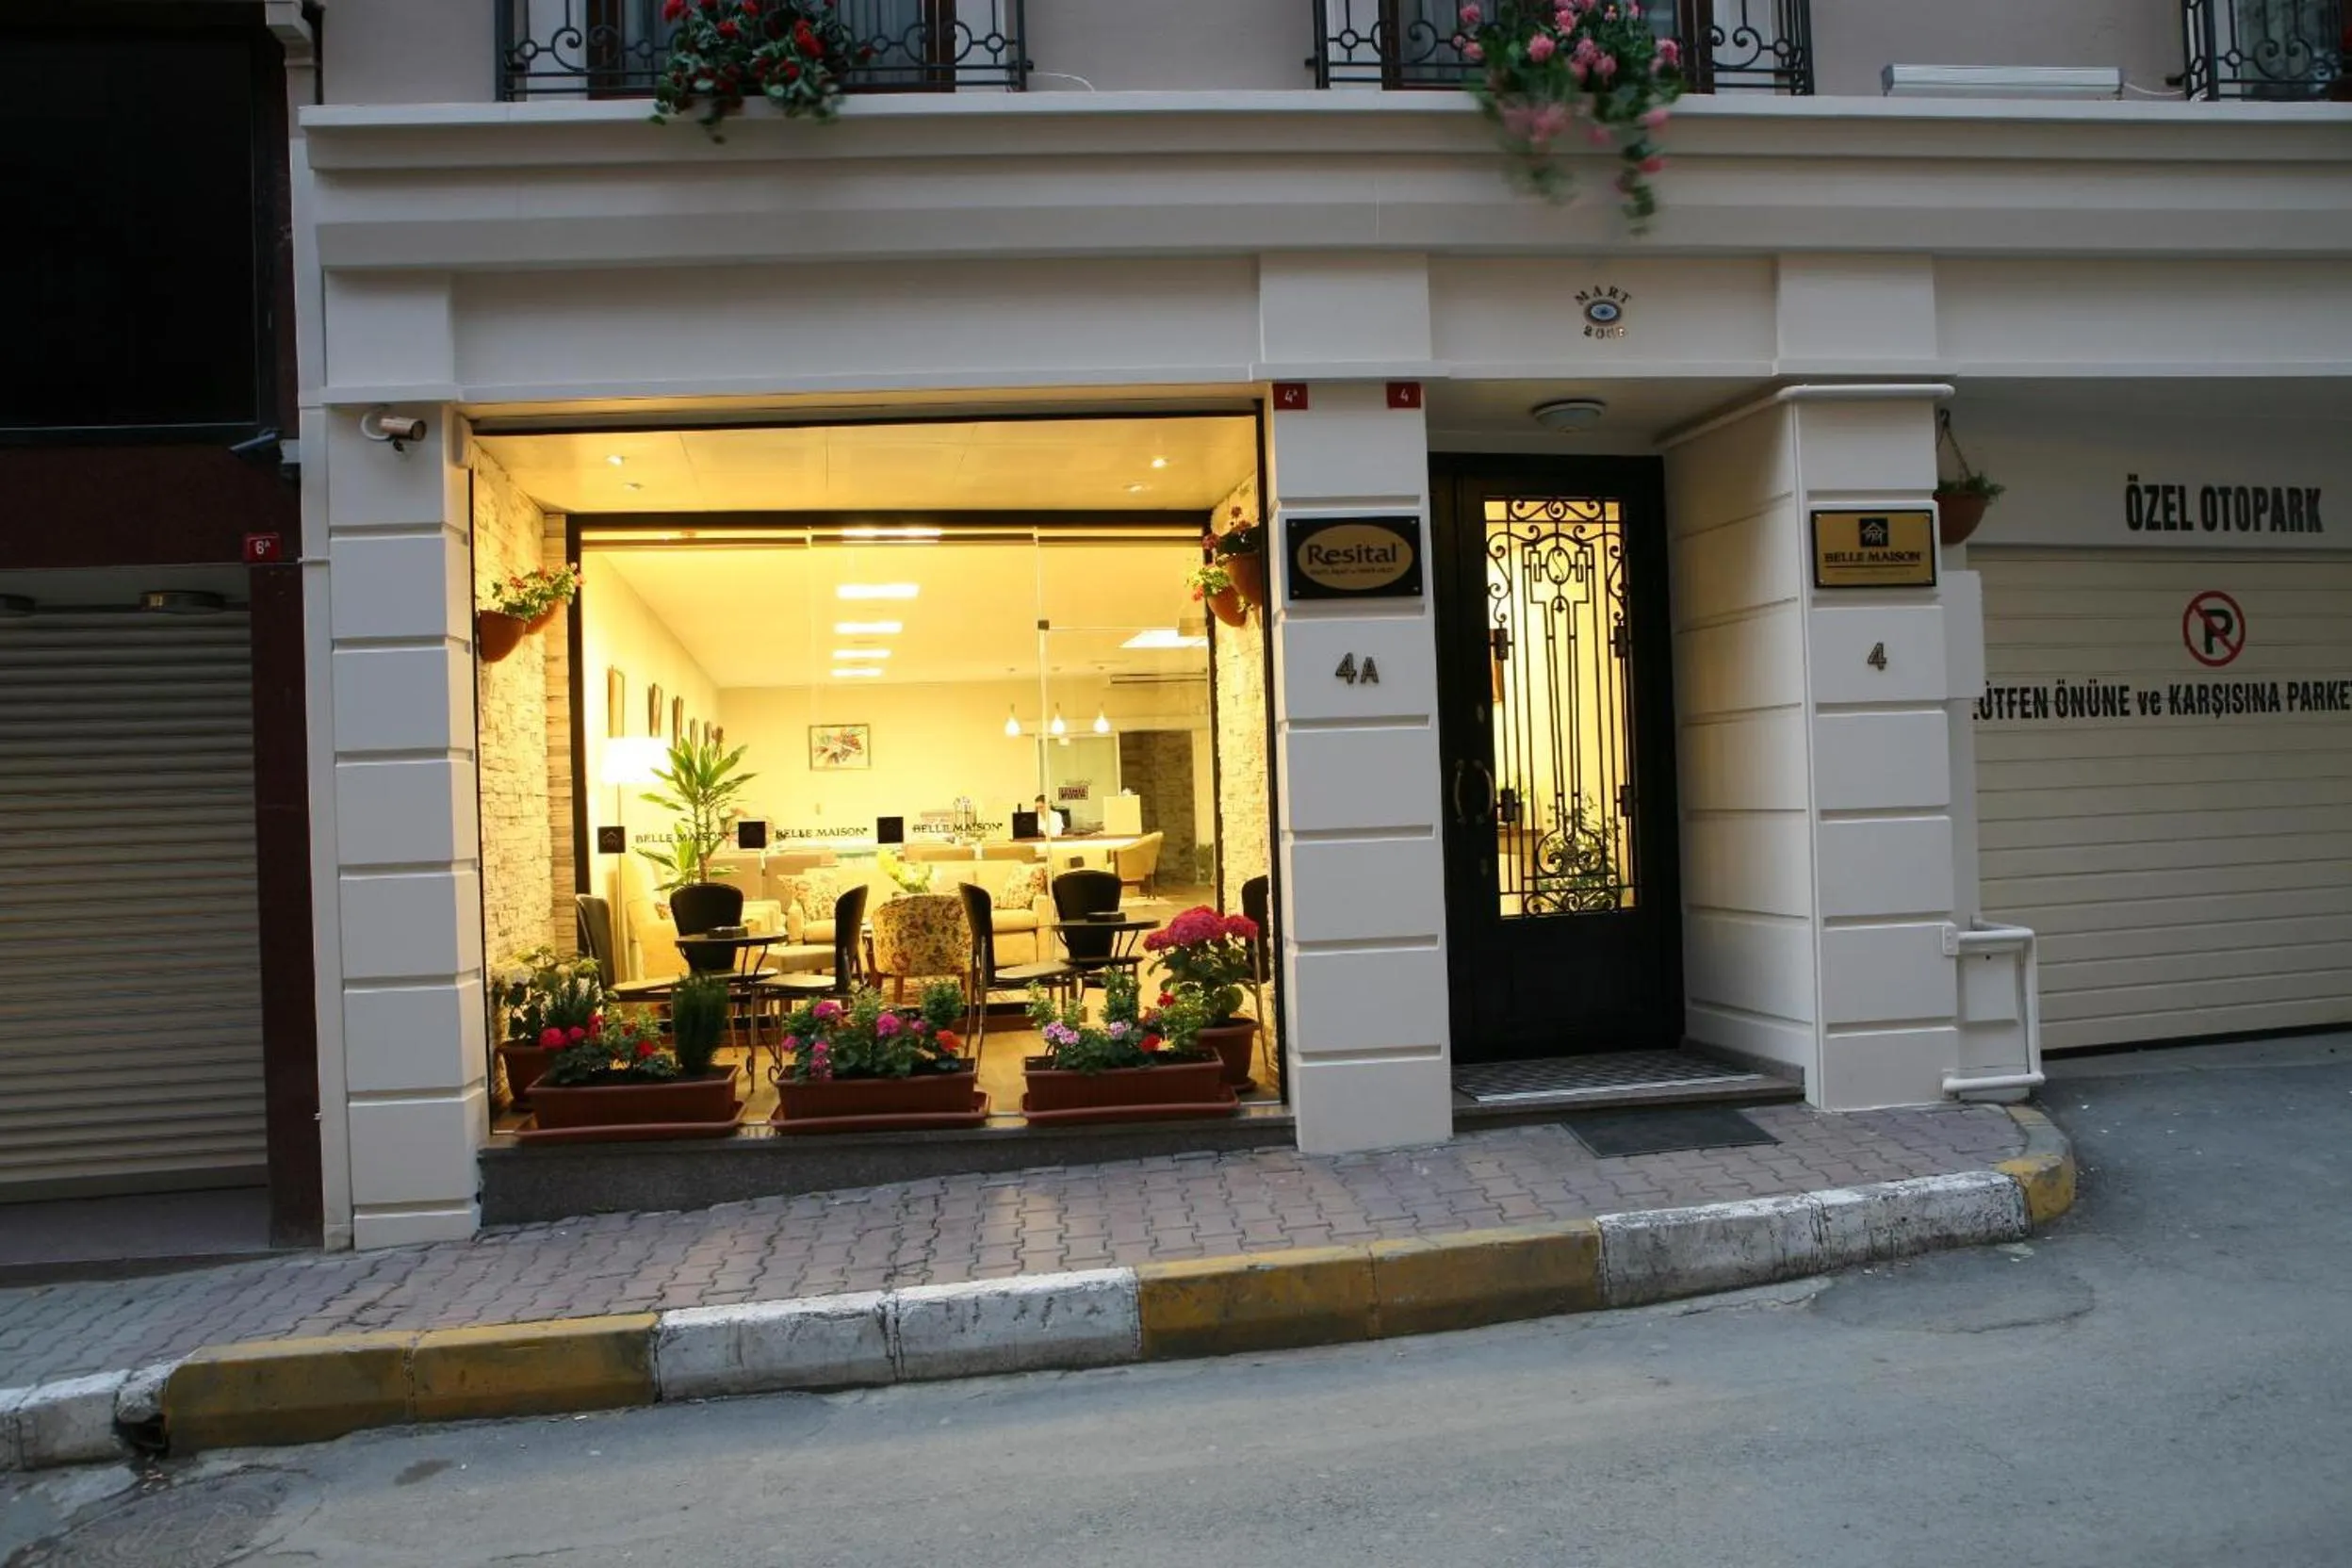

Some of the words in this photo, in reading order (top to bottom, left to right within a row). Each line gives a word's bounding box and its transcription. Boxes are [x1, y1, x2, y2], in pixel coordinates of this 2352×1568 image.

[1575, 285, 1632, 305] MART
[2125, 473, 2194, 531] ÖZEL
[2199, 485, 2325, 533] OTOPARK
[1307, 542, 1397, 565] Resital
[1823, 551, 1865, 563] BELLE
[1867, 549, 1921, 563] MAISON
[1335, 651, 1380, 685] 4A
[1867, 642, 1887, 671] 4
[1972, 679, 2049, 721] ÜTFEN
[2054, 678, 2132, 718] ÖNÜNE
[2137, 690, 2162, 716] ve
[2168, 681, 2281, 720] KARŞISINA
[635, 833, 673, 843] BELLE
[776, 828, 812, 840] BELLE
[816, 826, 865, 838] MAISON
[912, 824, 951, 834] BELLE
[953, 822, 1000, 832] MAISON
